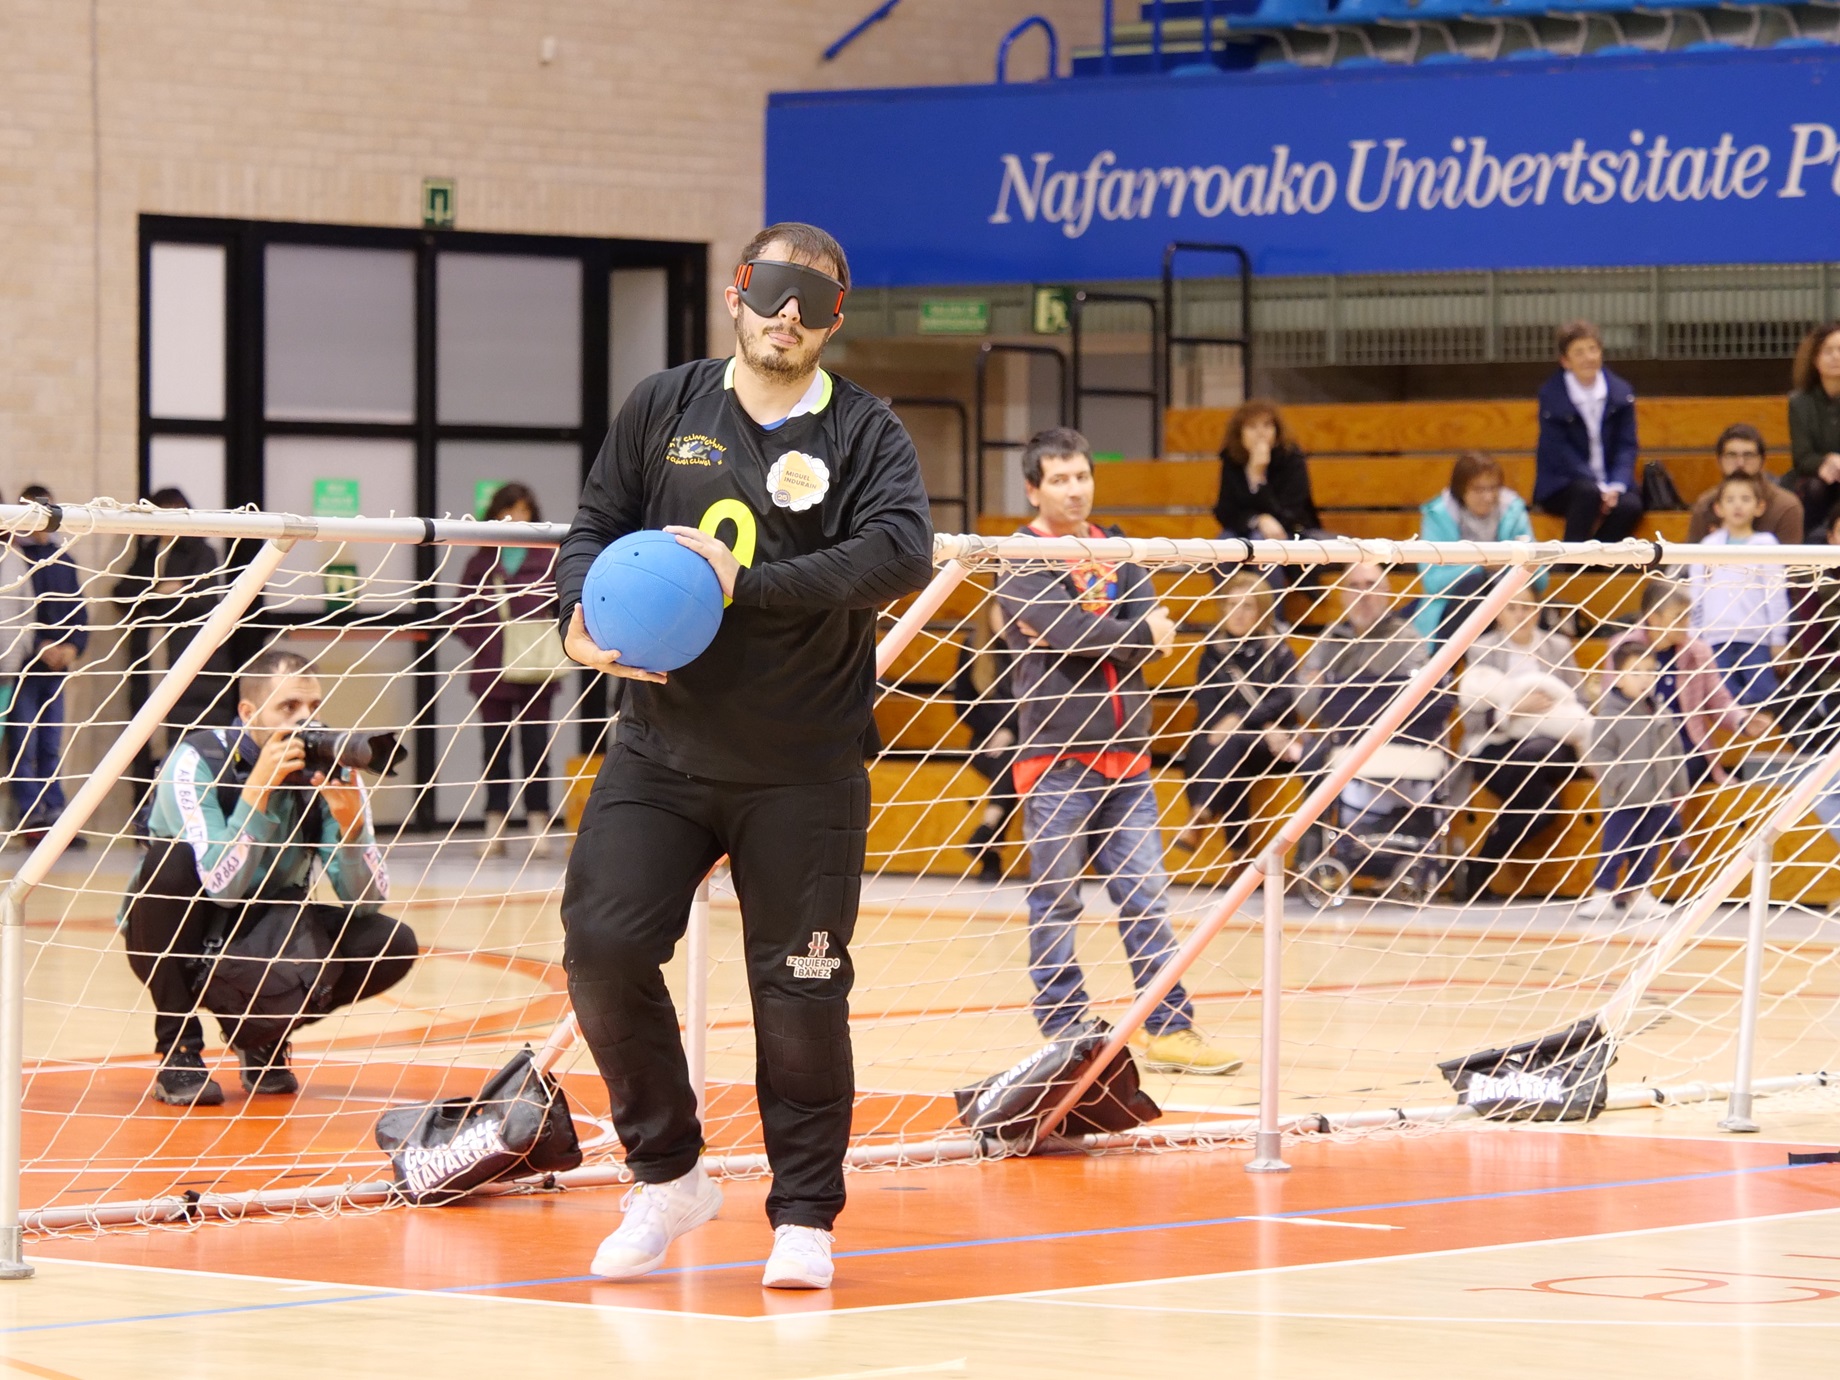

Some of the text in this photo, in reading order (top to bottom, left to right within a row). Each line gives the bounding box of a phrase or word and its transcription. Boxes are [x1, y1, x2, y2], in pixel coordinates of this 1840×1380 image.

[988, 144, 1338, 239] Nafarroako
[1345, 128, 1771, 213] Unibertsitate
[783, 476, 818, 489] INDURAIN
[785, 470, 811, 482] MIGUEL
[405, 1130, 506, 1196] NAVARRA
